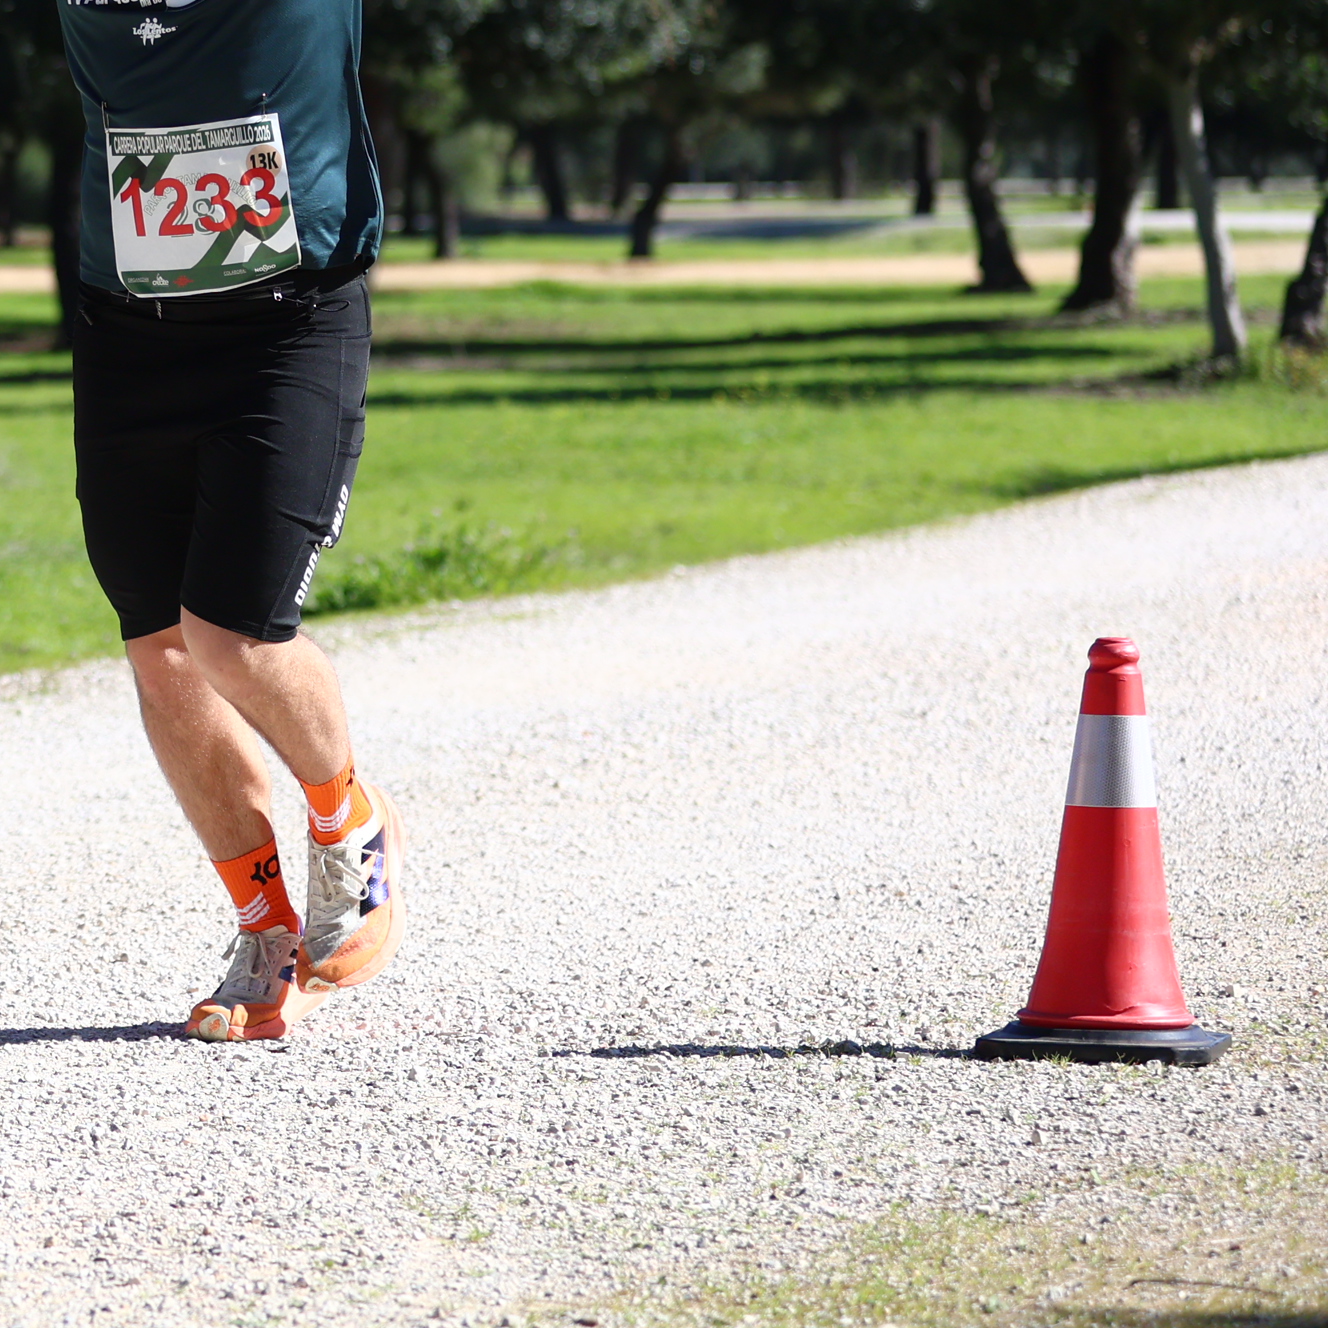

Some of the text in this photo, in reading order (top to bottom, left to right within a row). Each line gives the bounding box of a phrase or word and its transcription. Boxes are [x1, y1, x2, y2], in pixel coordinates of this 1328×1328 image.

[113, 136, 136, 154] CARRERA
[136, 135, 164, 154] POPULAR
[164, 133, 191, 154] PARQUE
[190, 131, 206, 150] DEL
[206, 126, 254, 148] TAMARGUILLO
[250, 152, 278, 170] 13K
[120, 167, 283, 237] 1233
[294, 535, 333, 607] SUDIO
